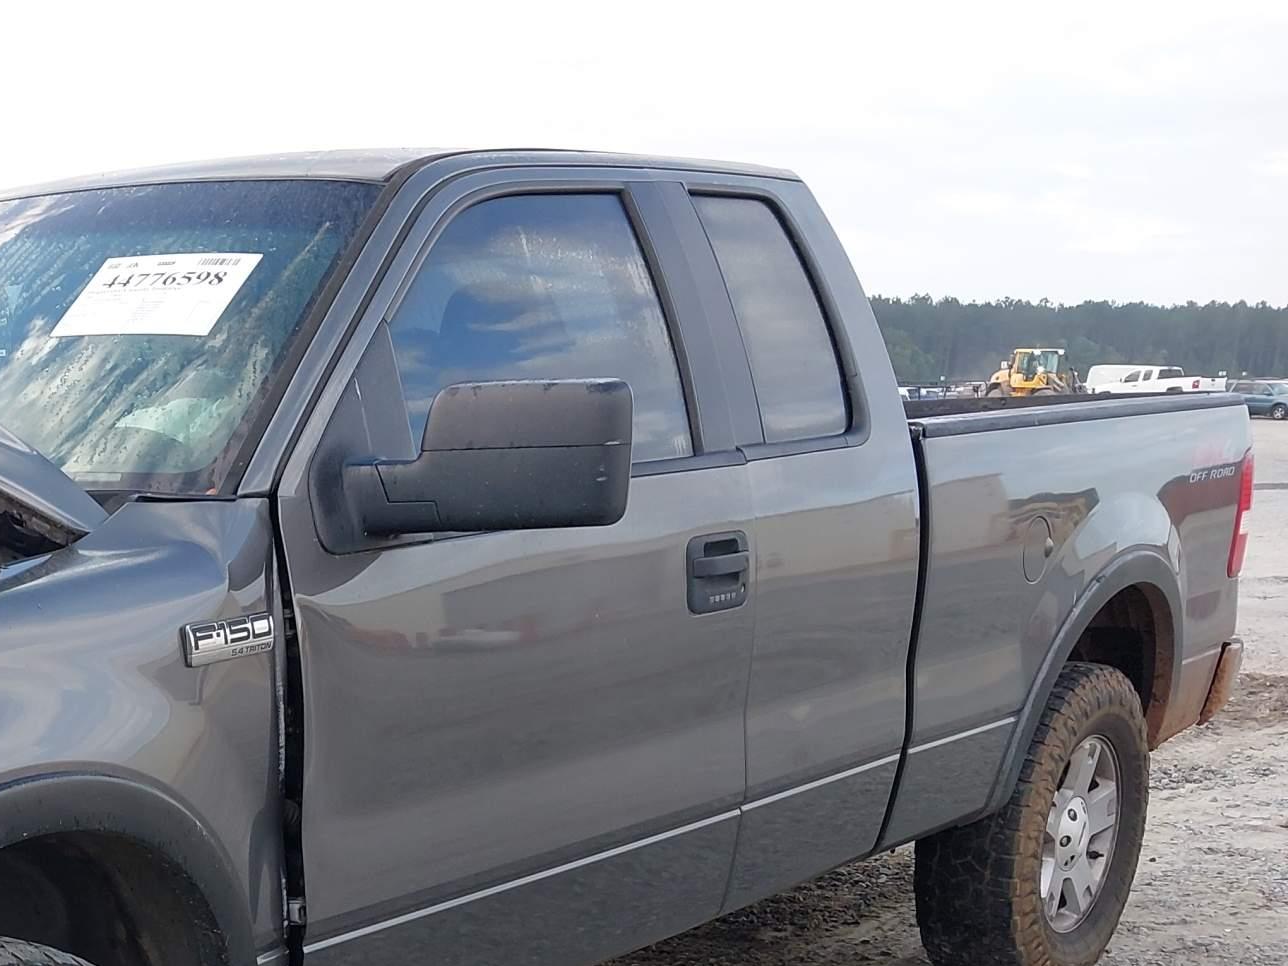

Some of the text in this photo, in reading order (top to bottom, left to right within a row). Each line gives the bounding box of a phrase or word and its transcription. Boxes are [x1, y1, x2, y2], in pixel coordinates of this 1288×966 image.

[102, 270, 228, 289] 44776598
[1189, 466, 1235, 484] OFF ROAD
